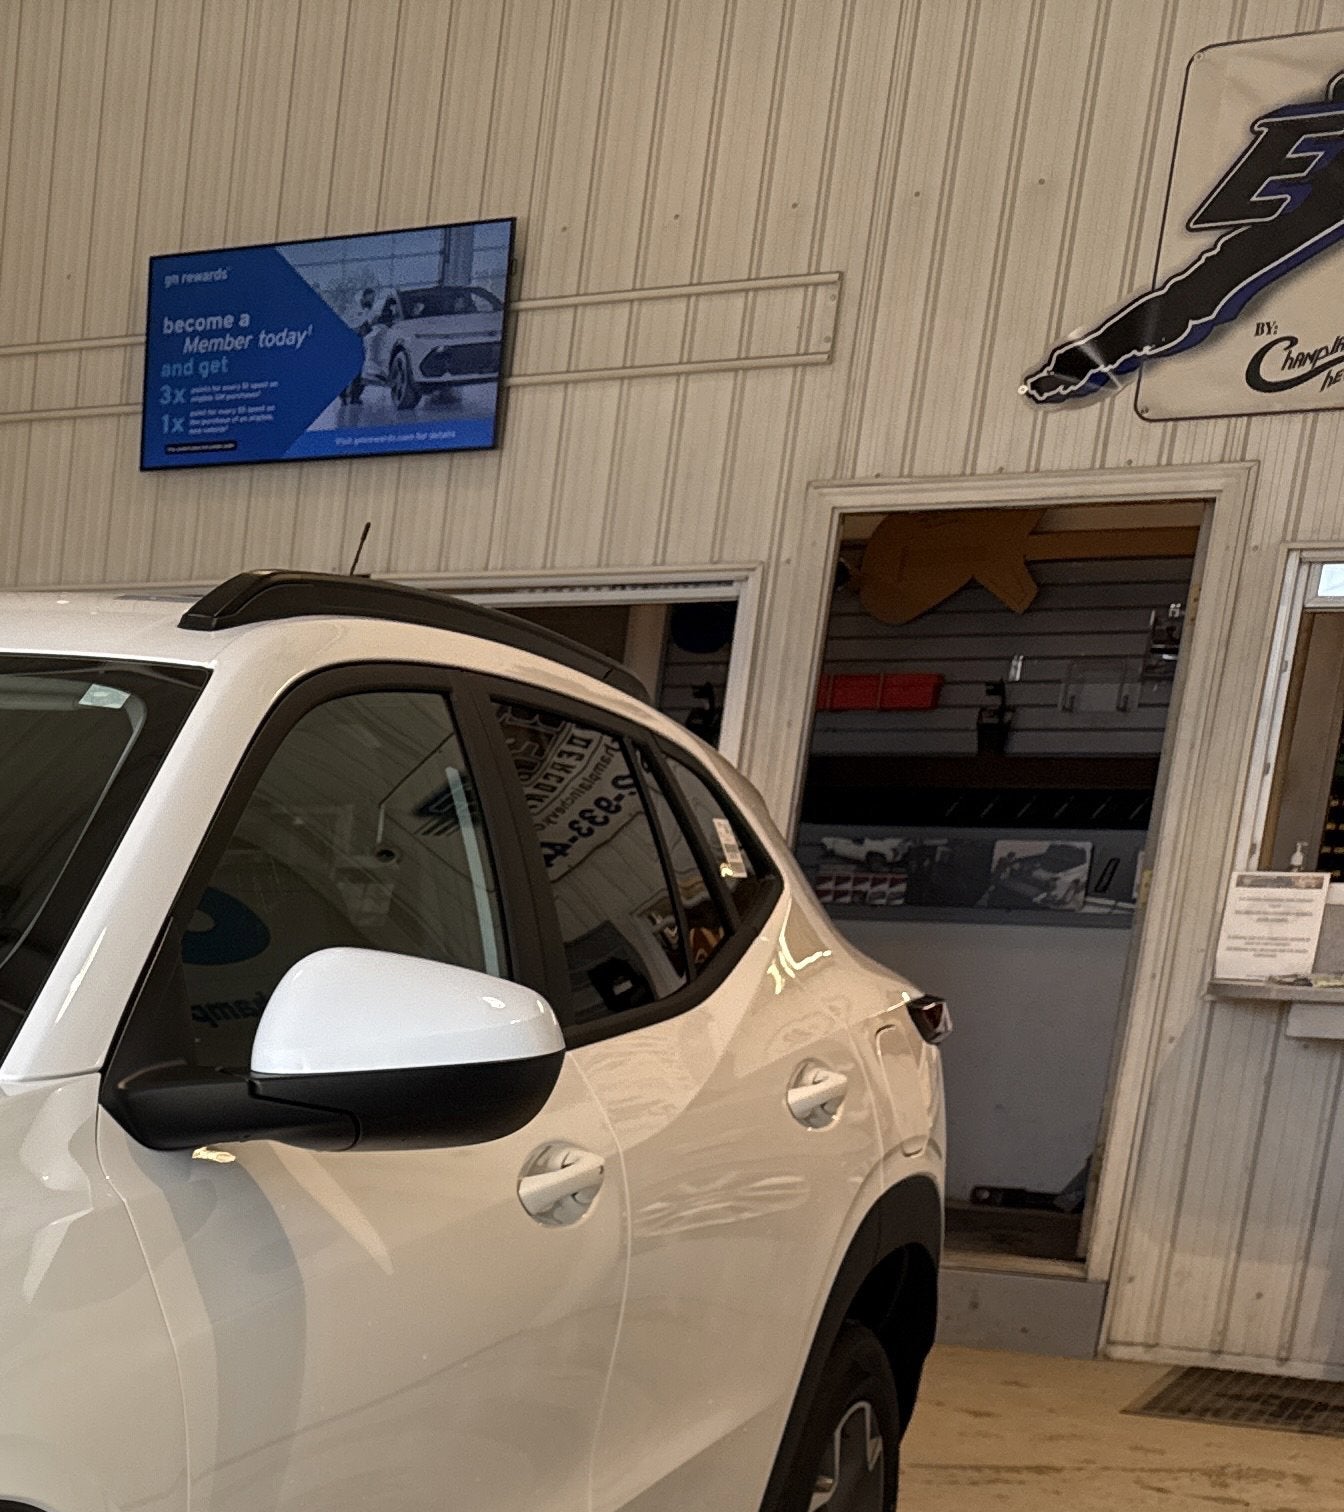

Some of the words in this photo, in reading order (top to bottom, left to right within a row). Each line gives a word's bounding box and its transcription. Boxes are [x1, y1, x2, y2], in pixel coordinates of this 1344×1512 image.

[163, 314, 234, 334] become
[239, 313, 250, 327] a
[1254, 321, 1278, 336] BY:
[183, 333, 253, 354] Member
[161, 357, 193, 378] and
[199, 355, 229, 379] get
[160, 384, 187, 405] 3x
[161, 414, 185, 434] 1x
